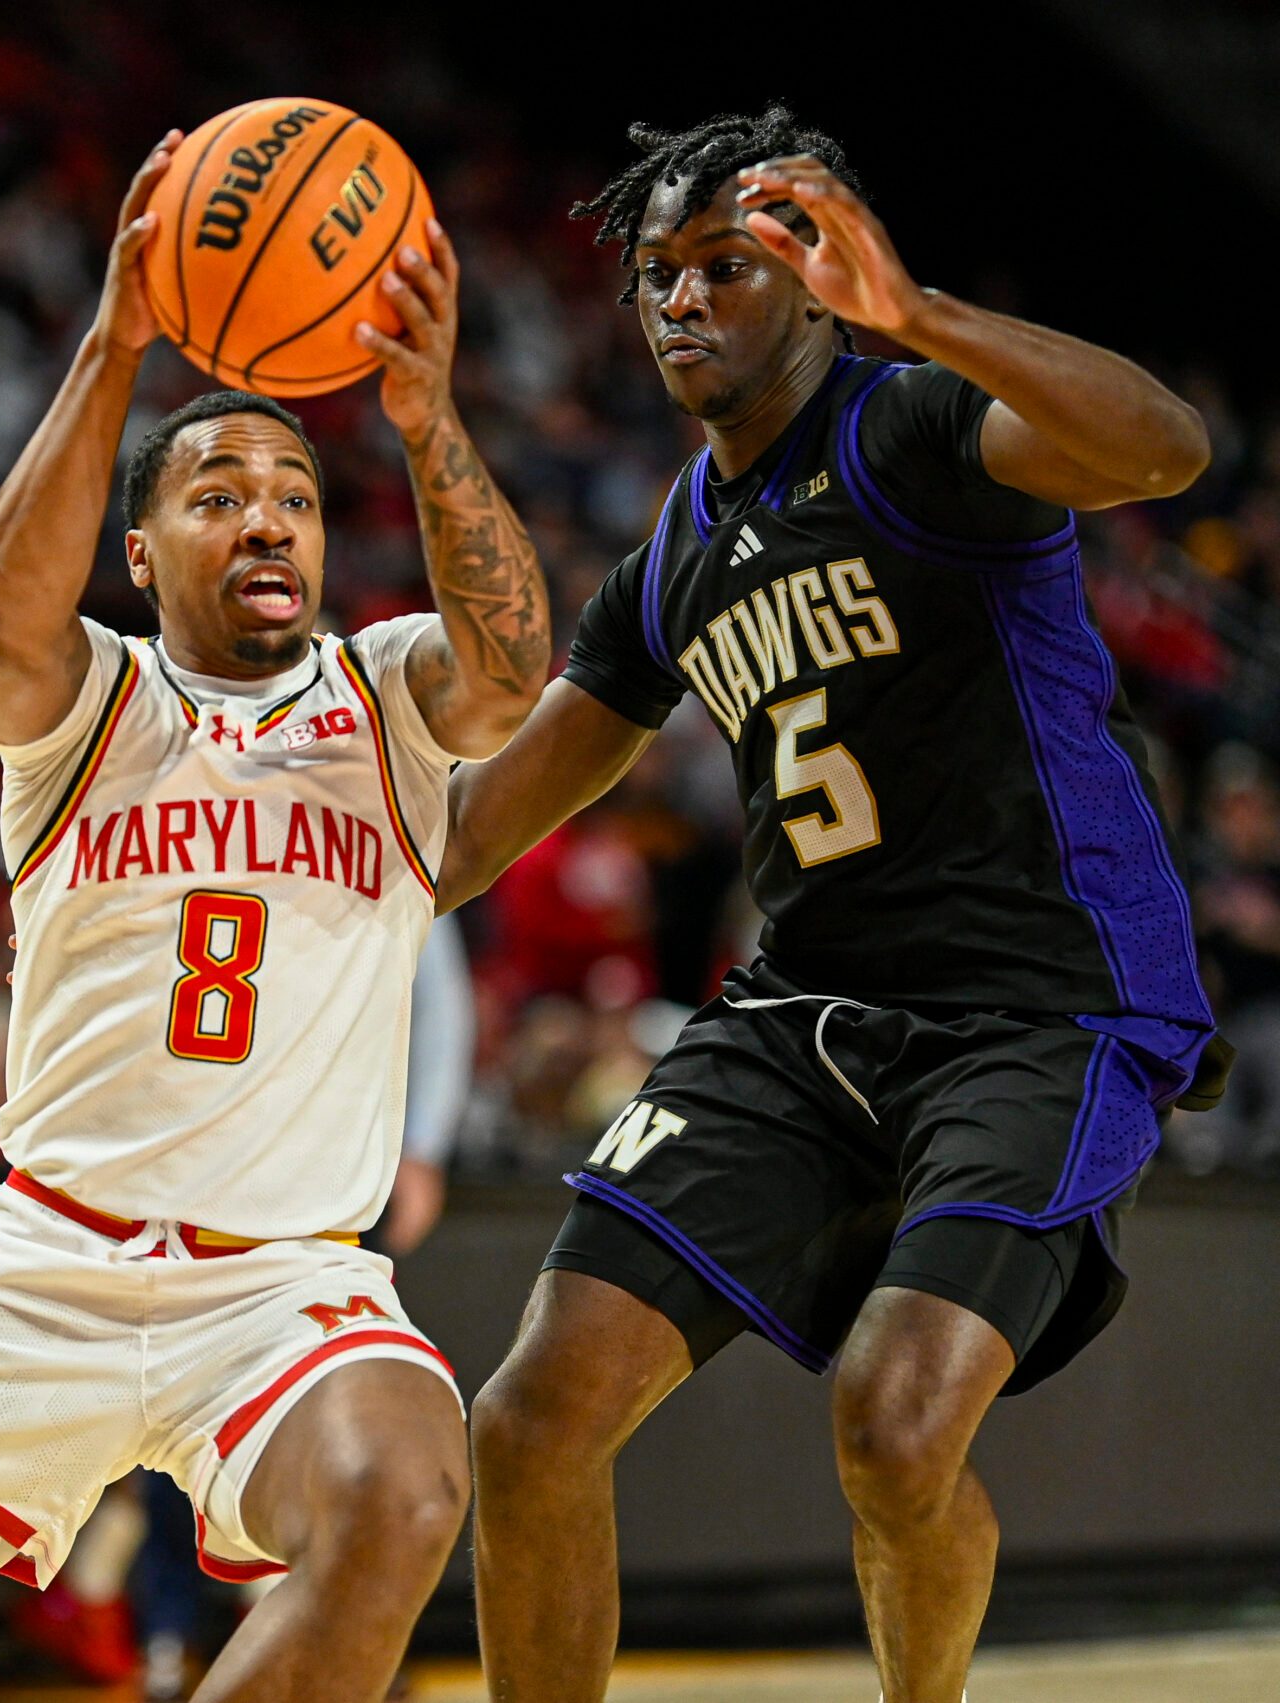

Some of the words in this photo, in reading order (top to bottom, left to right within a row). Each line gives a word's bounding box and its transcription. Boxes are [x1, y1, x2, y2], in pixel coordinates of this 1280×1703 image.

[196, 106, 330, 253] Wilson
[677, 557, 900, 744] DAWGS
[66, 798, 382, 900] MARYLAND
[766, 687, 881, 869] 5
[166, 888, 268, 1065] 8
[587, 1100, 689, 1174] W
[297, 1295, 399, 1337] M
